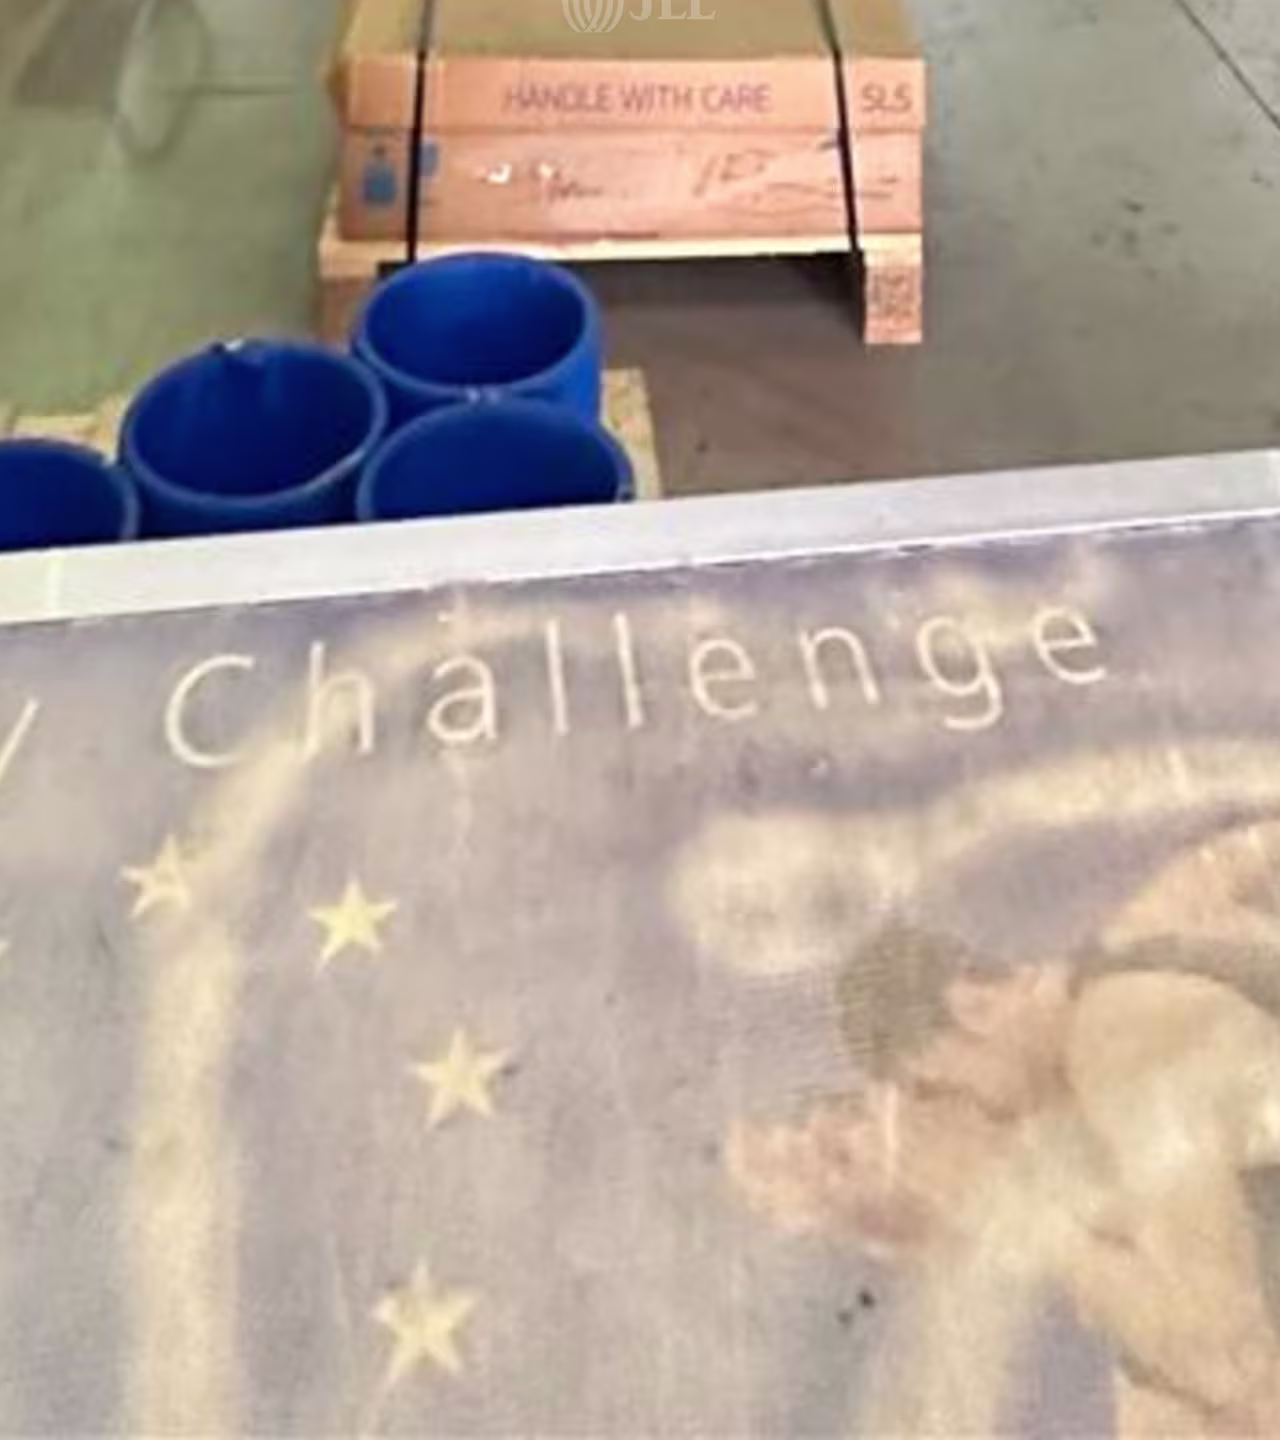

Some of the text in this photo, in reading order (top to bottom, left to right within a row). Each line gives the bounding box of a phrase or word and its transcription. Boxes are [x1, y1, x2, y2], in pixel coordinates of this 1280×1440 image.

[506, 83, 773, 114] HANDLE WITH CARE
[164, 605, 1108, 769] Challenge
